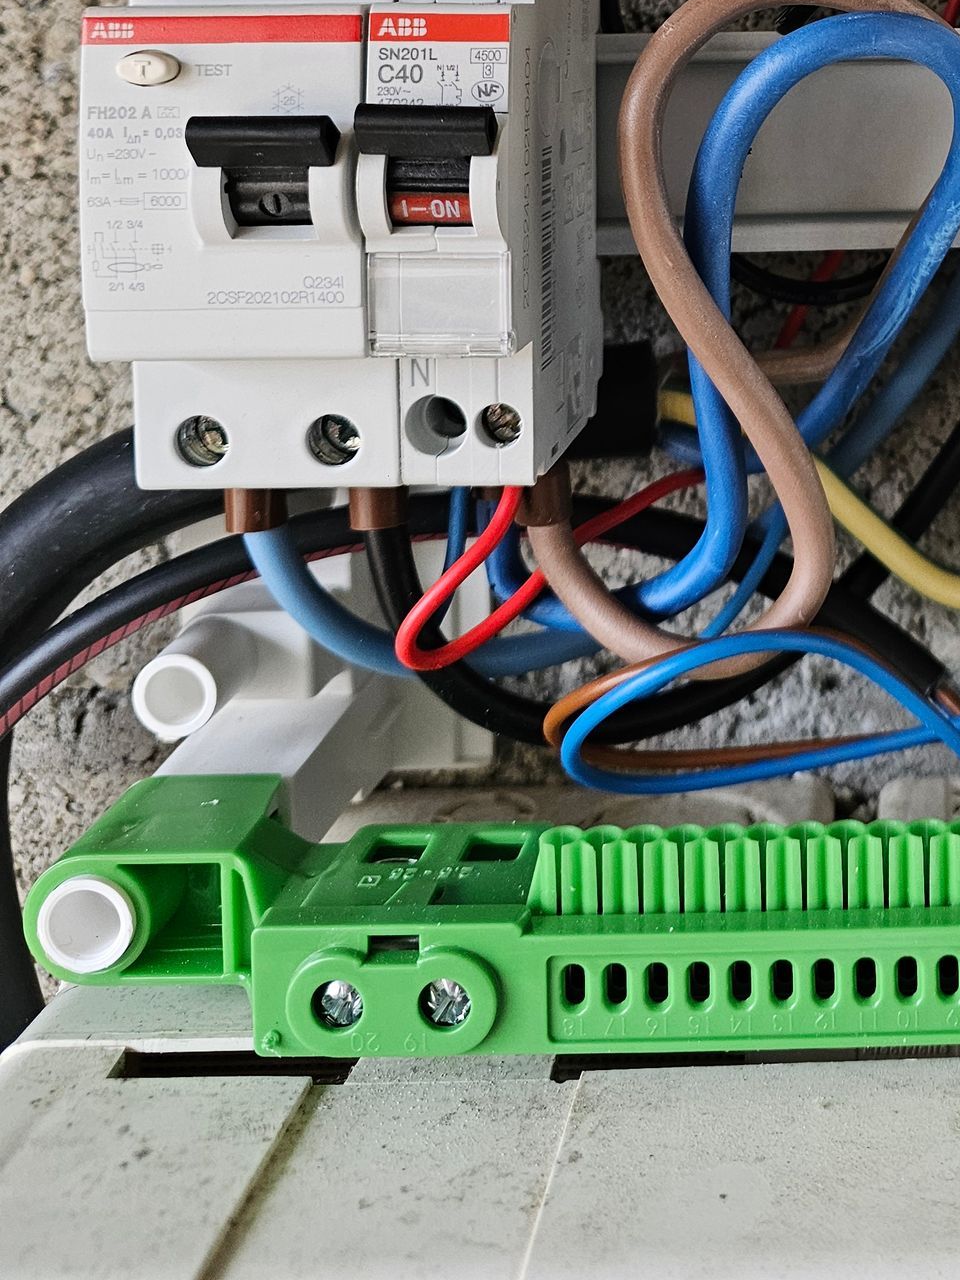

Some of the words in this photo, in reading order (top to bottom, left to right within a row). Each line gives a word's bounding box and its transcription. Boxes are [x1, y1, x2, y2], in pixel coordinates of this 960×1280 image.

[90, 22, 135, 39] ABB
[377, 17, 428, 37] ABB
[378, 47, 438, 61] SN201L
[474, 49, 502, 62] 4500
[194, 63, 233, 78] TEST
[377, 63, 424, 84] C40
[484, 65, 492, 77] 3
[87, 106, 138, 120] FH202
[141, 106, 152, 120] A
[87, 127, 115, 140] 40A
[150, 195, 182, 207] 6000
[206, 291, 345, 306] 2CSF202102R1400
[410, 358, 430, 387] N
